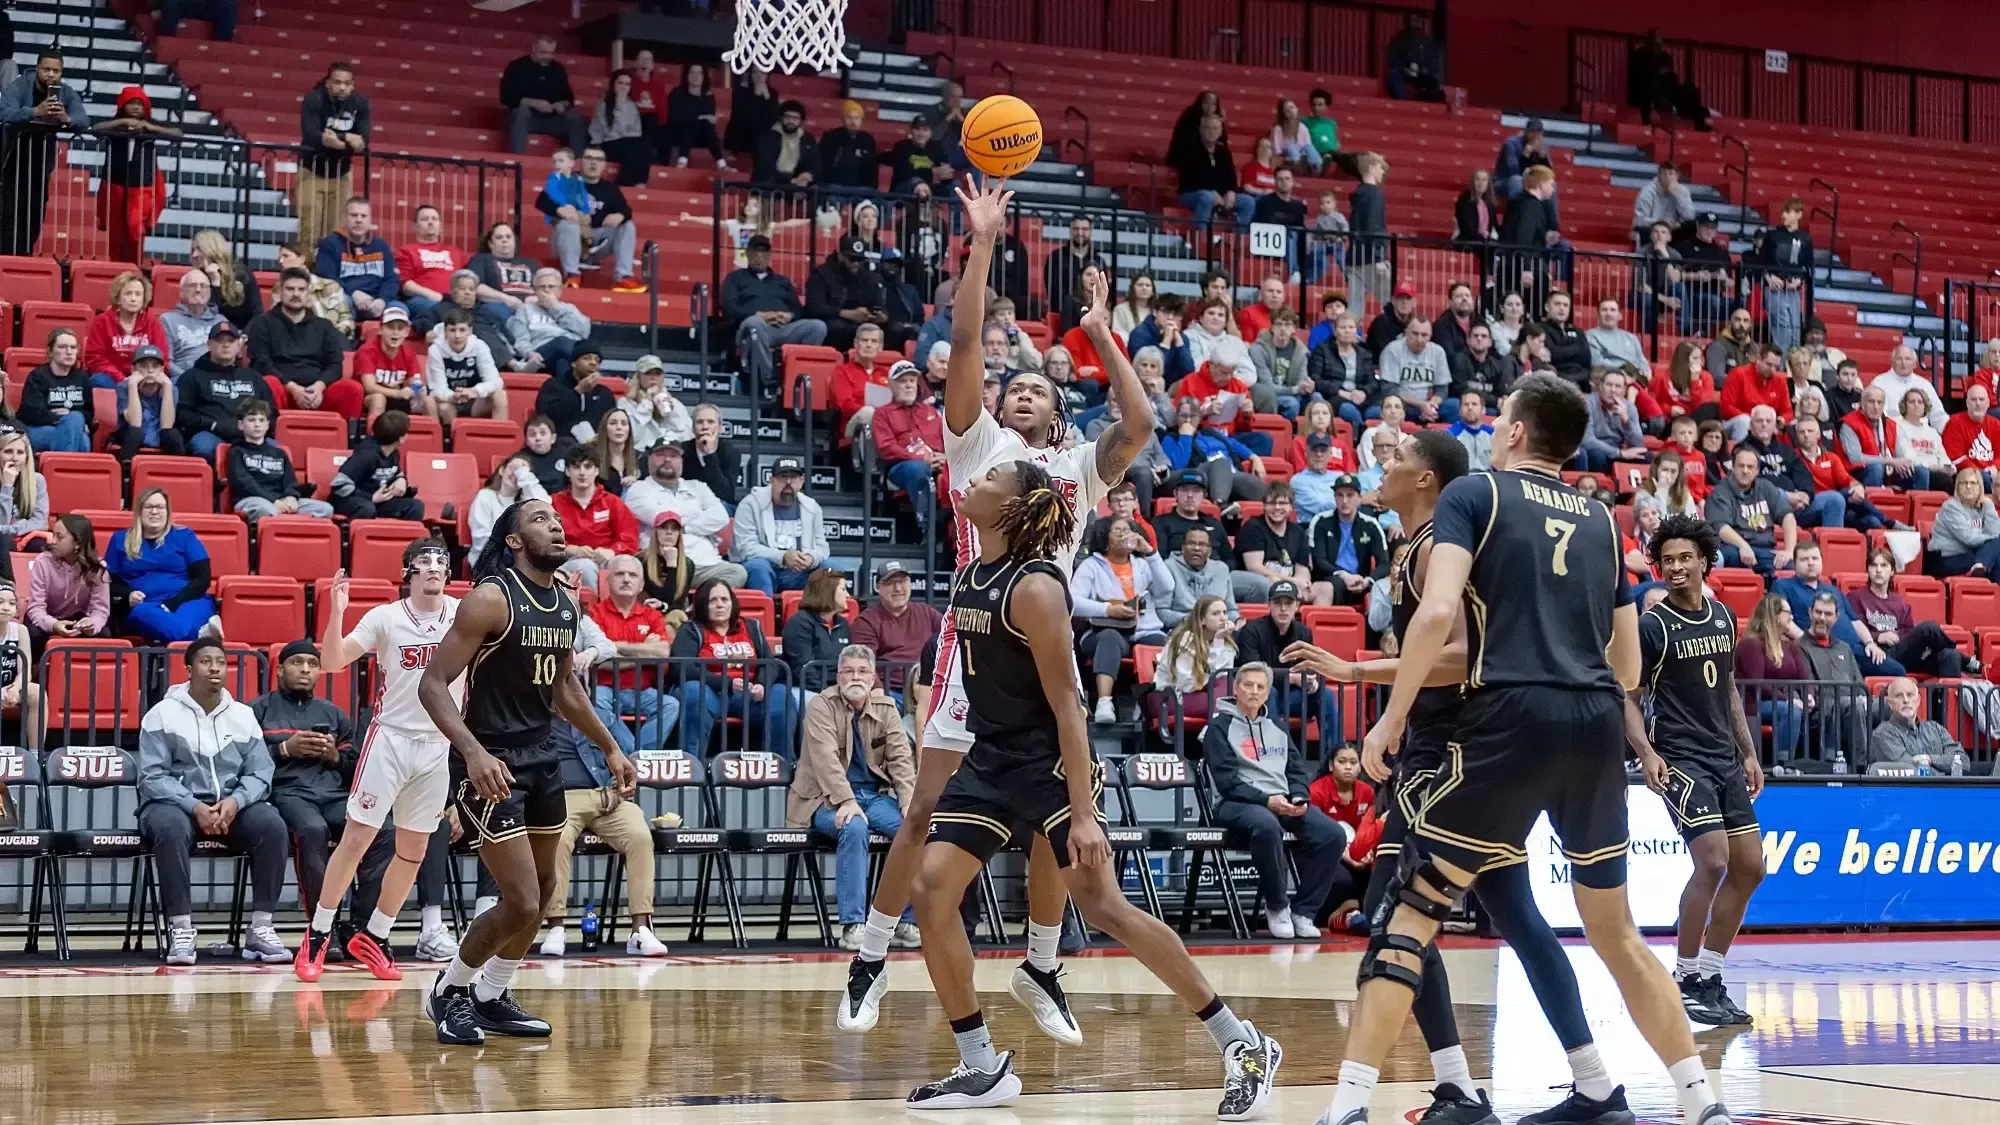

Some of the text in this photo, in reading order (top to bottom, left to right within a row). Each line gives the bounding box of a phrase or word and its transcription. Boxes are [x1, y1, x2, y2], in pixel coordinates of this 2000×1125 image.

[1767, 55, 1785, 68] 212
[990, 131, 1039, 152] Wilson
[1253, 232, 1282, 249] 110
[1402, 366, 1435, 383] DAD
[1519, 478, 1591, 517] NENADIC
[1544, 516, 1577, 576] 7
[521, 625, 573, 649] LINDENWOOD
[1675, 634, 1731, 659] LINDENWOOD
[964, 639, 976, 676] 1
[532, 653, 557, 686] 10
[1703, 659, 1718, 688] 0
[61, 756, 123, 778] SIUE
[636, 759, 692, 780] SIUE
[725, 759, 779, 780] SIUE
[1136, 761, 1186, 780] SIUE
[93, 835, 141, 845] COUGARS
[676, 833, 719, 843] COUGARS
[766, 833, 807, 843] COUGARS
[1186, 832, 1223, 841] COUGARS
[1762, 831, 1822, 875] We
